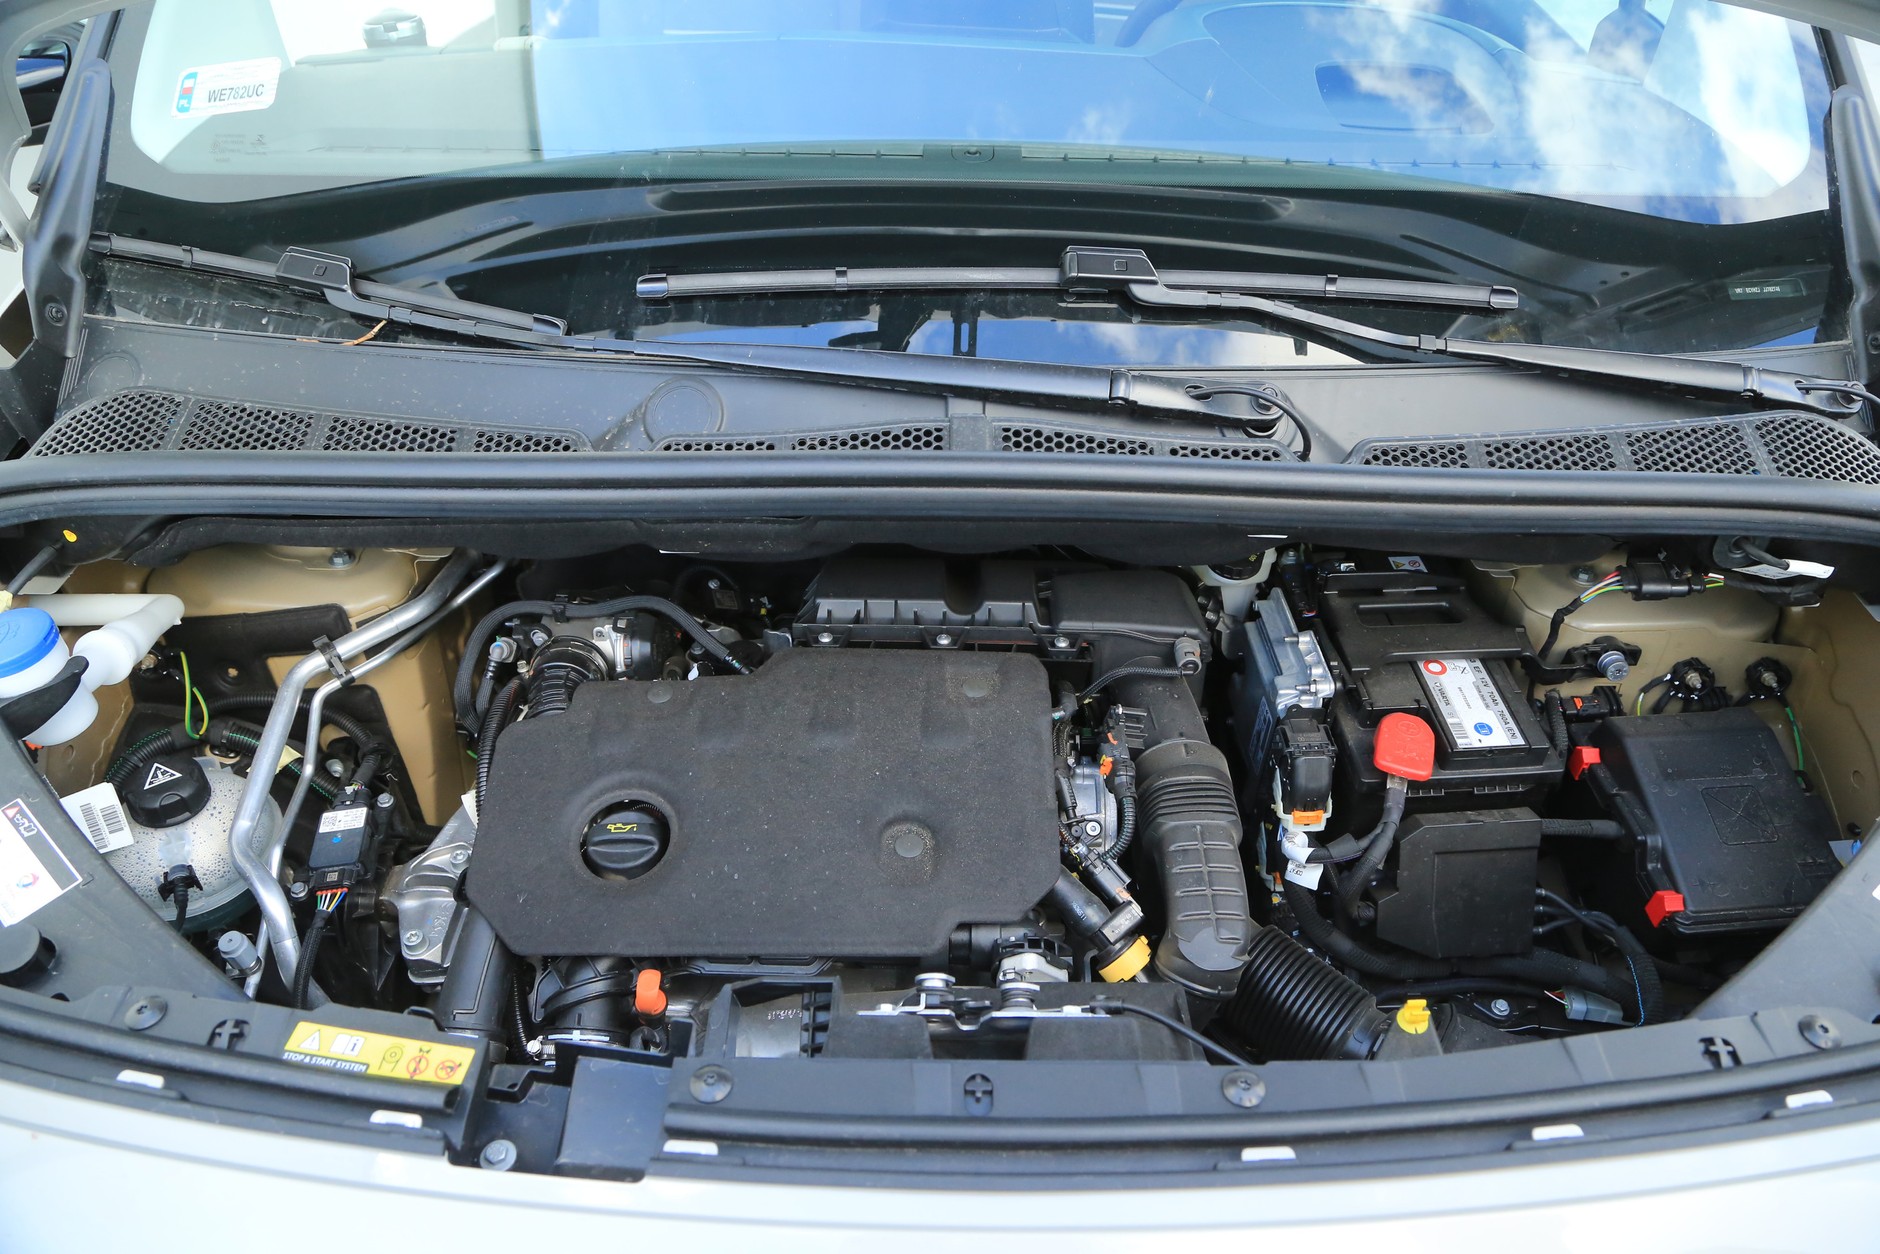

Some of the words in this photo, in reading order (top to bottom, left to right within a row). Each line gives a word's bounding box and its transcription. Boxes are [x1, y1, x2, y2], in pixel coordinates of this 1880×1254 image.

[208, 84, 264, 103] WE782UC
[1438, 686, 1450, 706] VARTA
[1480, 677, 1490, 688] 12V
[1487, 691, 1500, 706] 70Ah
[283, 1051, 304, 1062] STOP
[304, 1055, 310, 1063] &
[310, 1056, 334, 1068] START
[335, 1060, 367, 1073] SYSTEM
